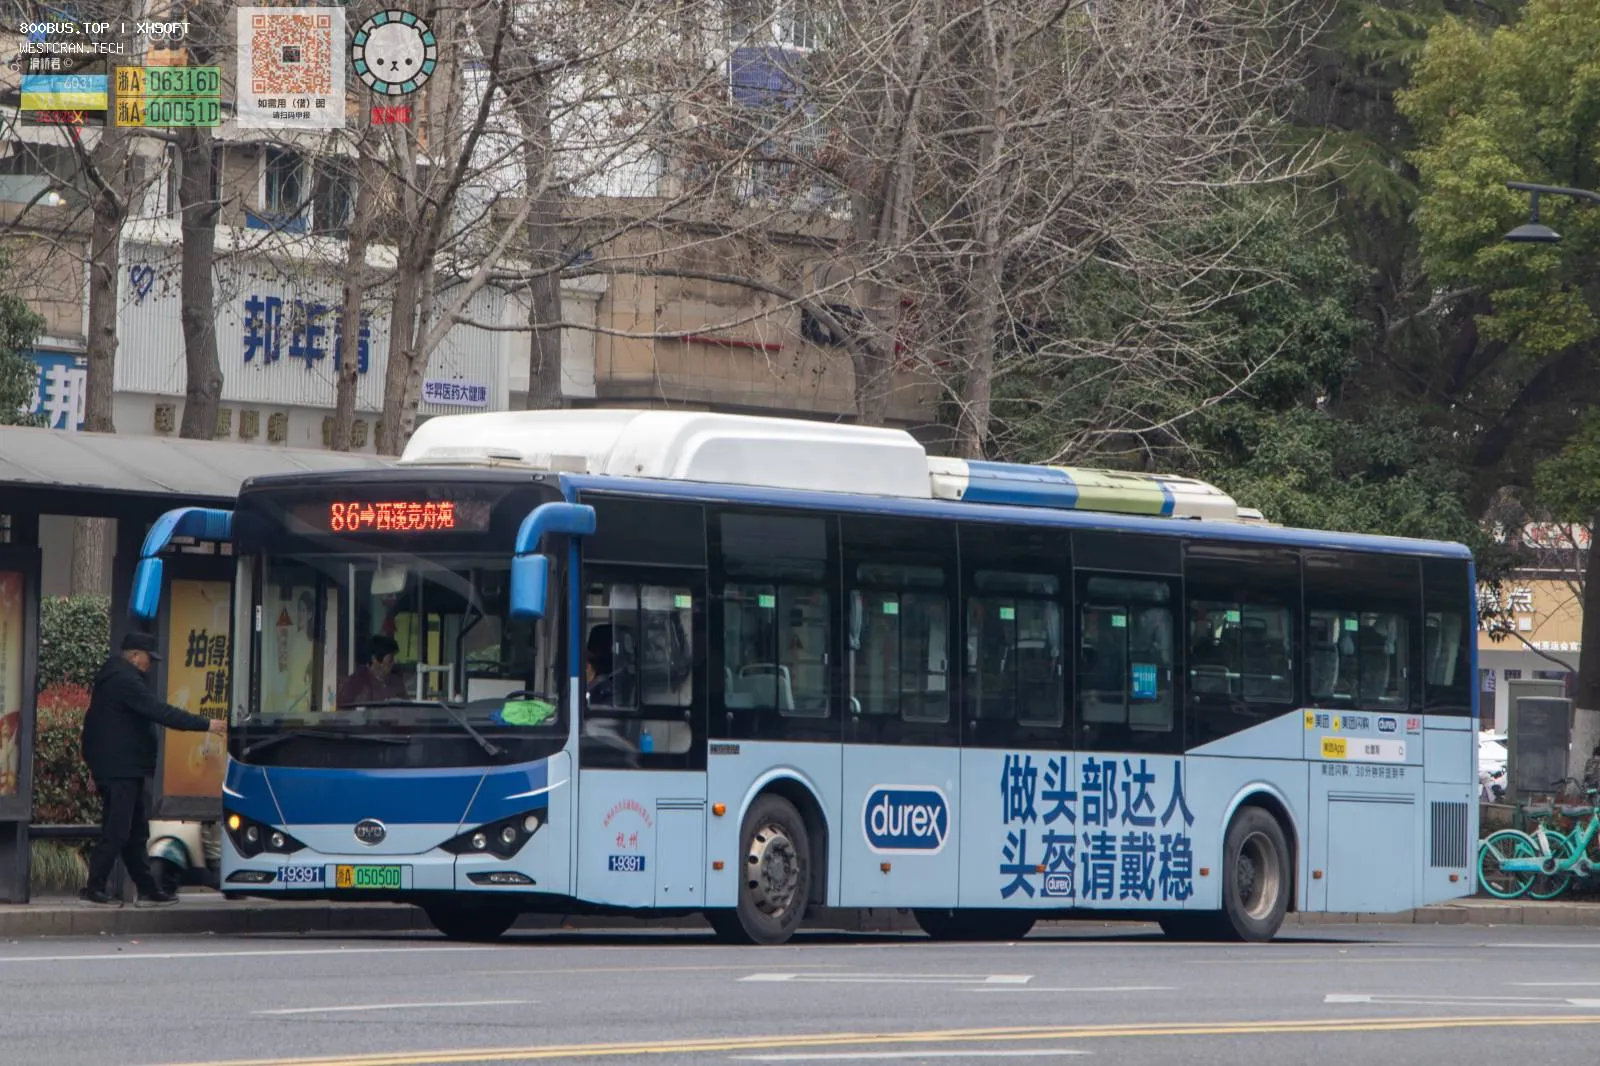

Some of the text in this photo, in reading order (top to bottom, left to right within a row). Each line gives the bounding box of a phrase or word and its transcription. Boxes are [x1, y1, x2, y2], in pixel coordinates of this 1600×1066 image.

[330, 502, 360, 531] 86
[1000, 754, 1195, 828] 做头部达人
[870, 795, 943, 843] durex
[1048, 877, 1069, 890] durex
